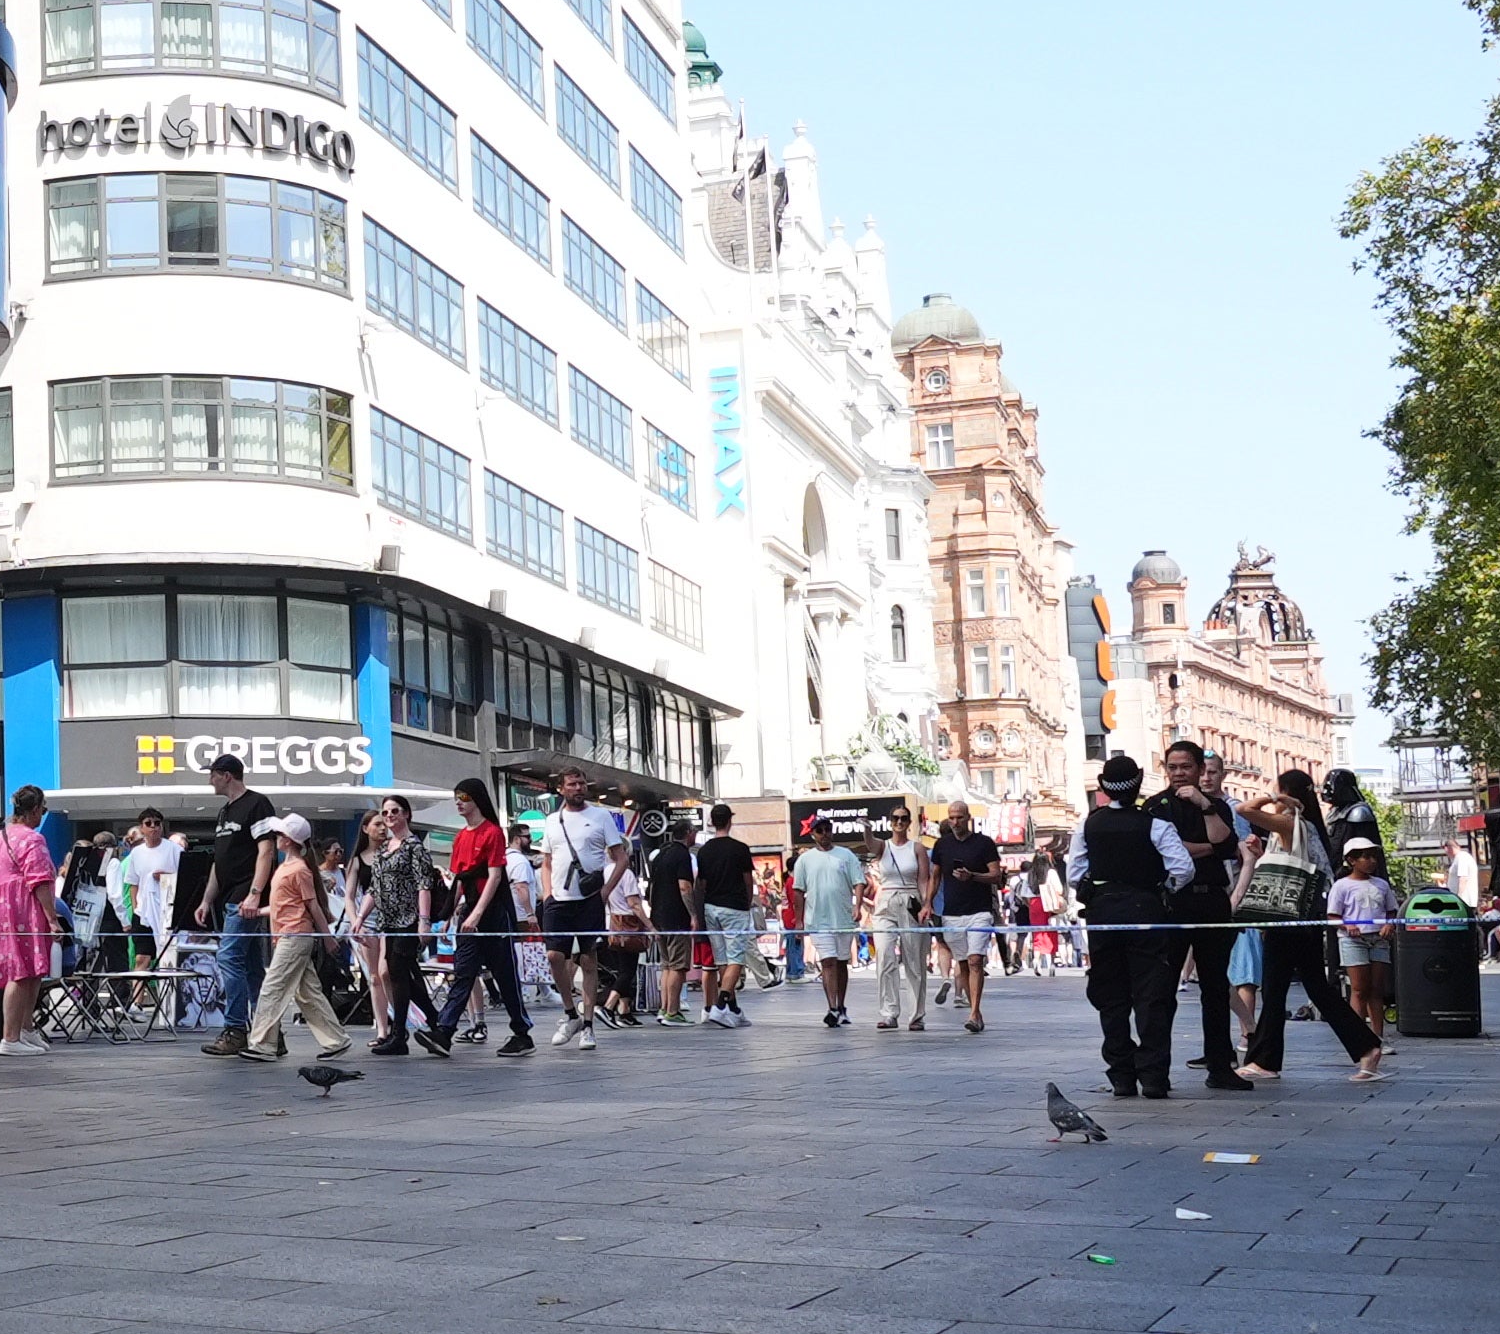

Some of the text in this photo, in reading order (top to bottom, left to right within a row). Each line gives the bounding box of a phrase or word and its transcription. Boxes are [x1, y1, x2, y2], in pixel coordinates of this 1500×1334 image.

[39, 101, 356, 175] hotel INDIGO
[709, 365, 745, 518] IMAX
[186, 735, 373, 775] GREGGS
[515, 793, 551, 815] WEST END
